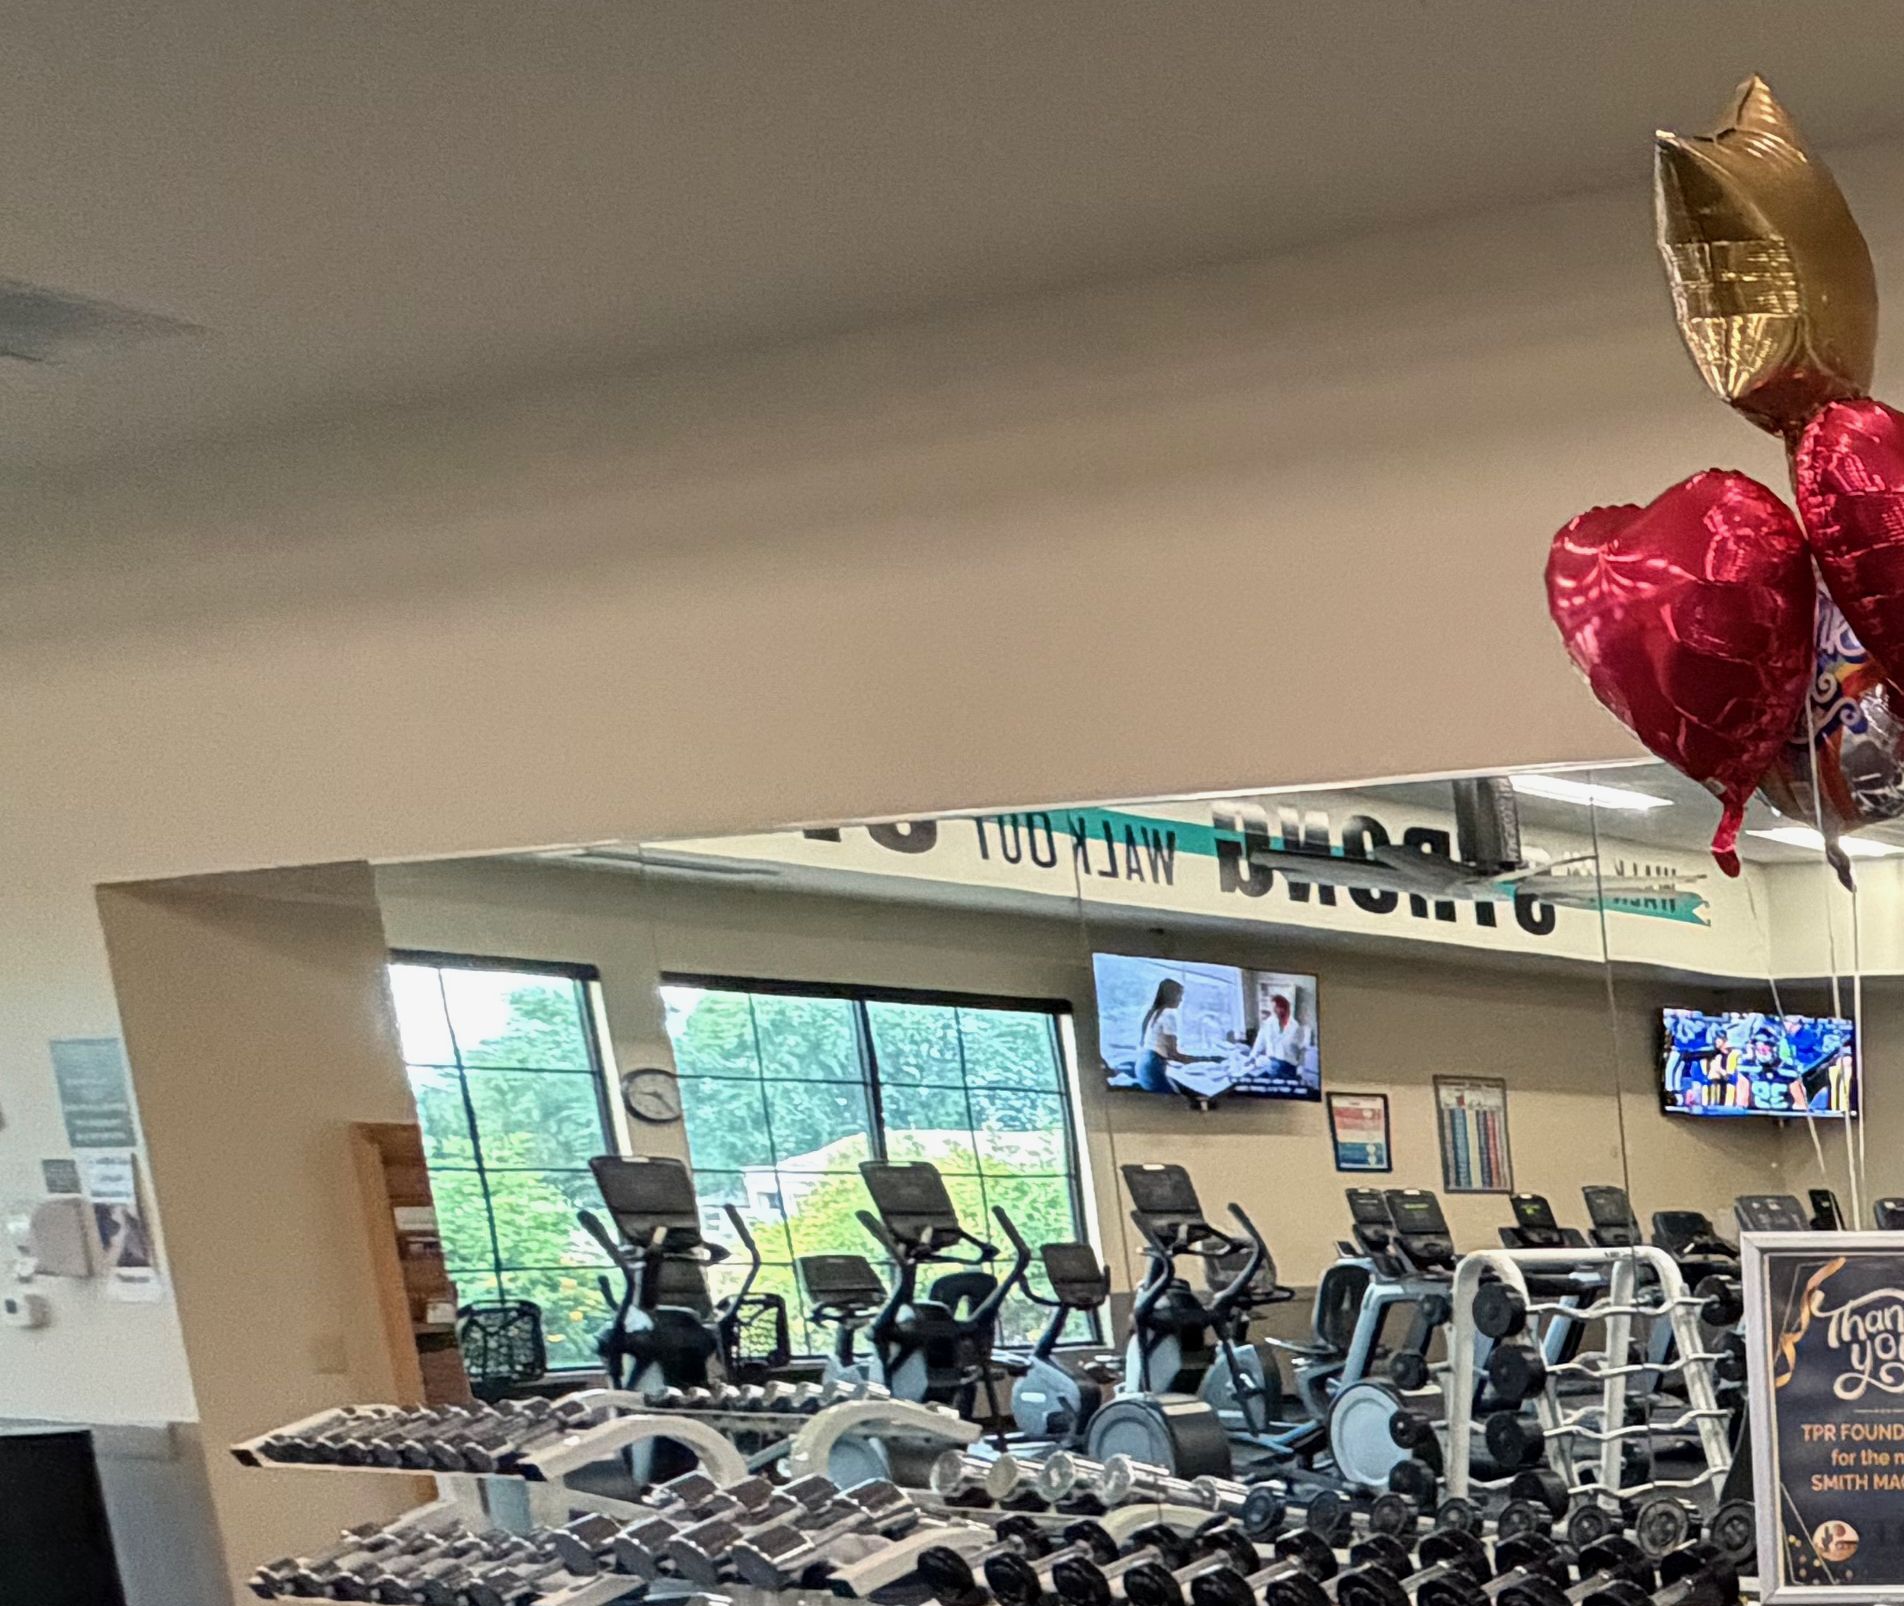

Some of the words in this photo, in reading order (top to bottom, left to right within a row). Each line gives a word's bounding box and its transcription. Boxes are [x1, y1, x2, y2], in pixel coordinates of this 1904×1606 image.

[1801, 1424, 1837, 1442] TPR
[1831, 1449, 1856, 1466] for
[1860, 1449, 1891, 1466] the
[1811, 1474, 1869, 1491] SMITH
